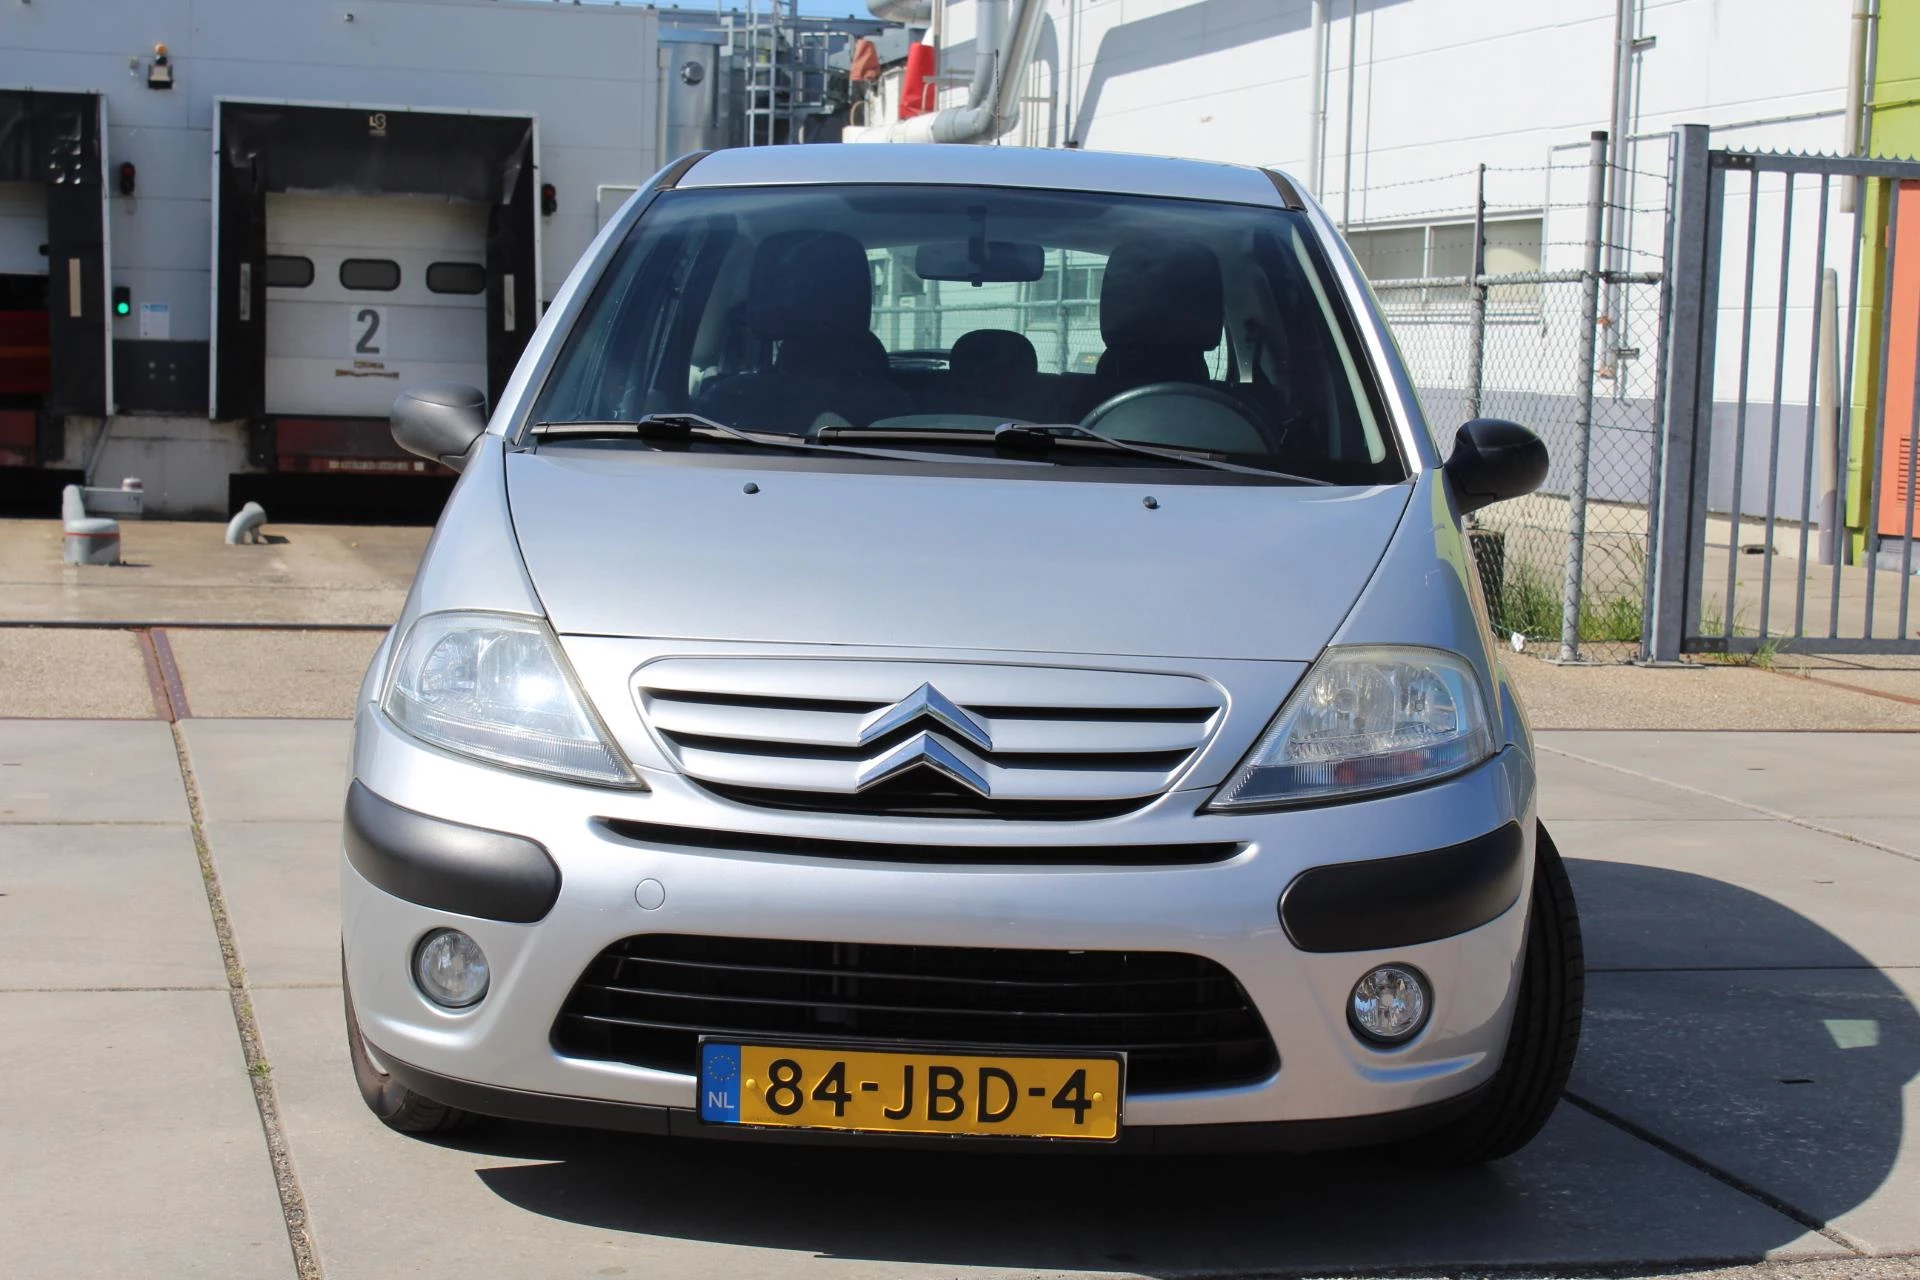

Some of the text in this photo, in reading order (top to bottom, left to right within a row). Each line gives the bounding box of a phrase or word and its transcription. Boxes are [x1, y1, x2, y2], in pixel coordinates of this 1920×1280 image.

[356, 309, 380, 354] 2
[708, 1091, 735, 1109] NL
[765, 1058, 1092, 1125] 84-JBD-4
